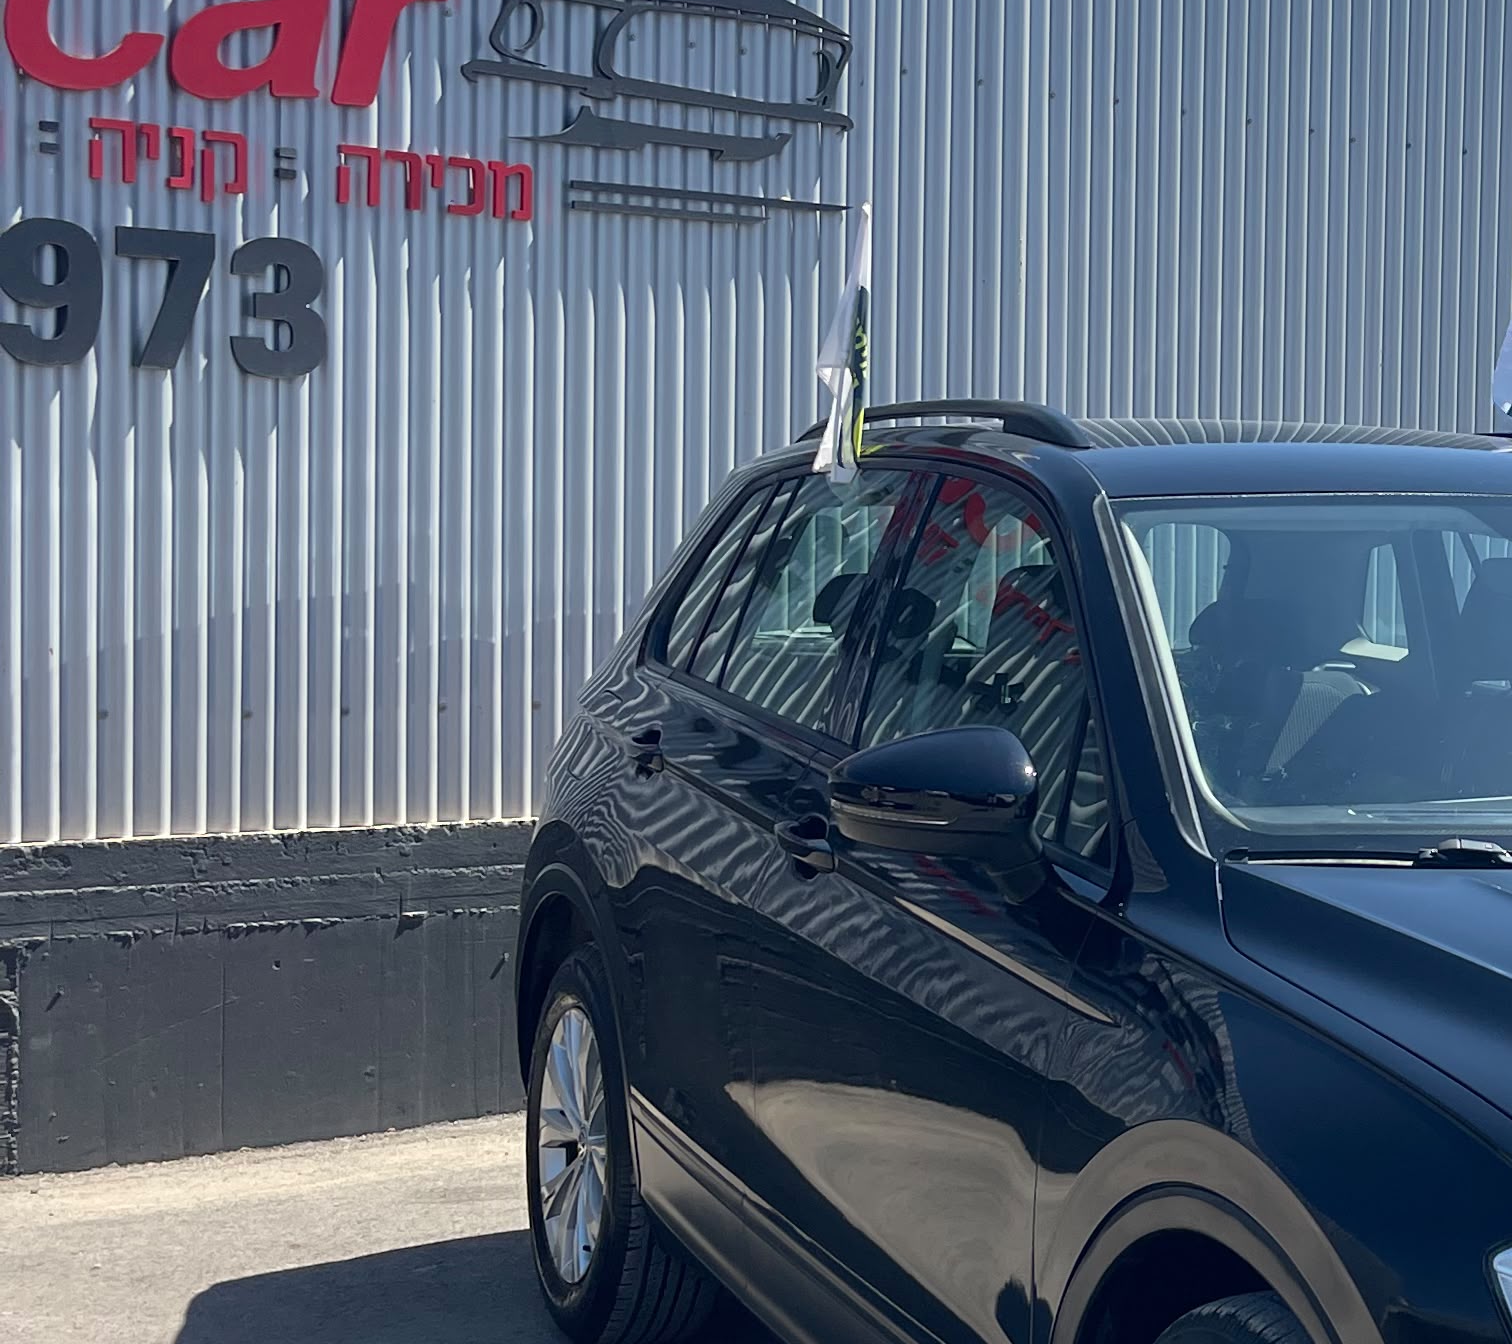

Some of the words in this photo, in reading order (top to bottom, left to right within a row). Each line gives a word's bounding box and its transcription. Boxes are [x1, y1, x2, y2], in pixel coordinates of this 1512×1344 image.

[89, 117, 248, 202] קניה
[337, 144, 533, 221] מכירה
[0, 217, 328, 377] 973
